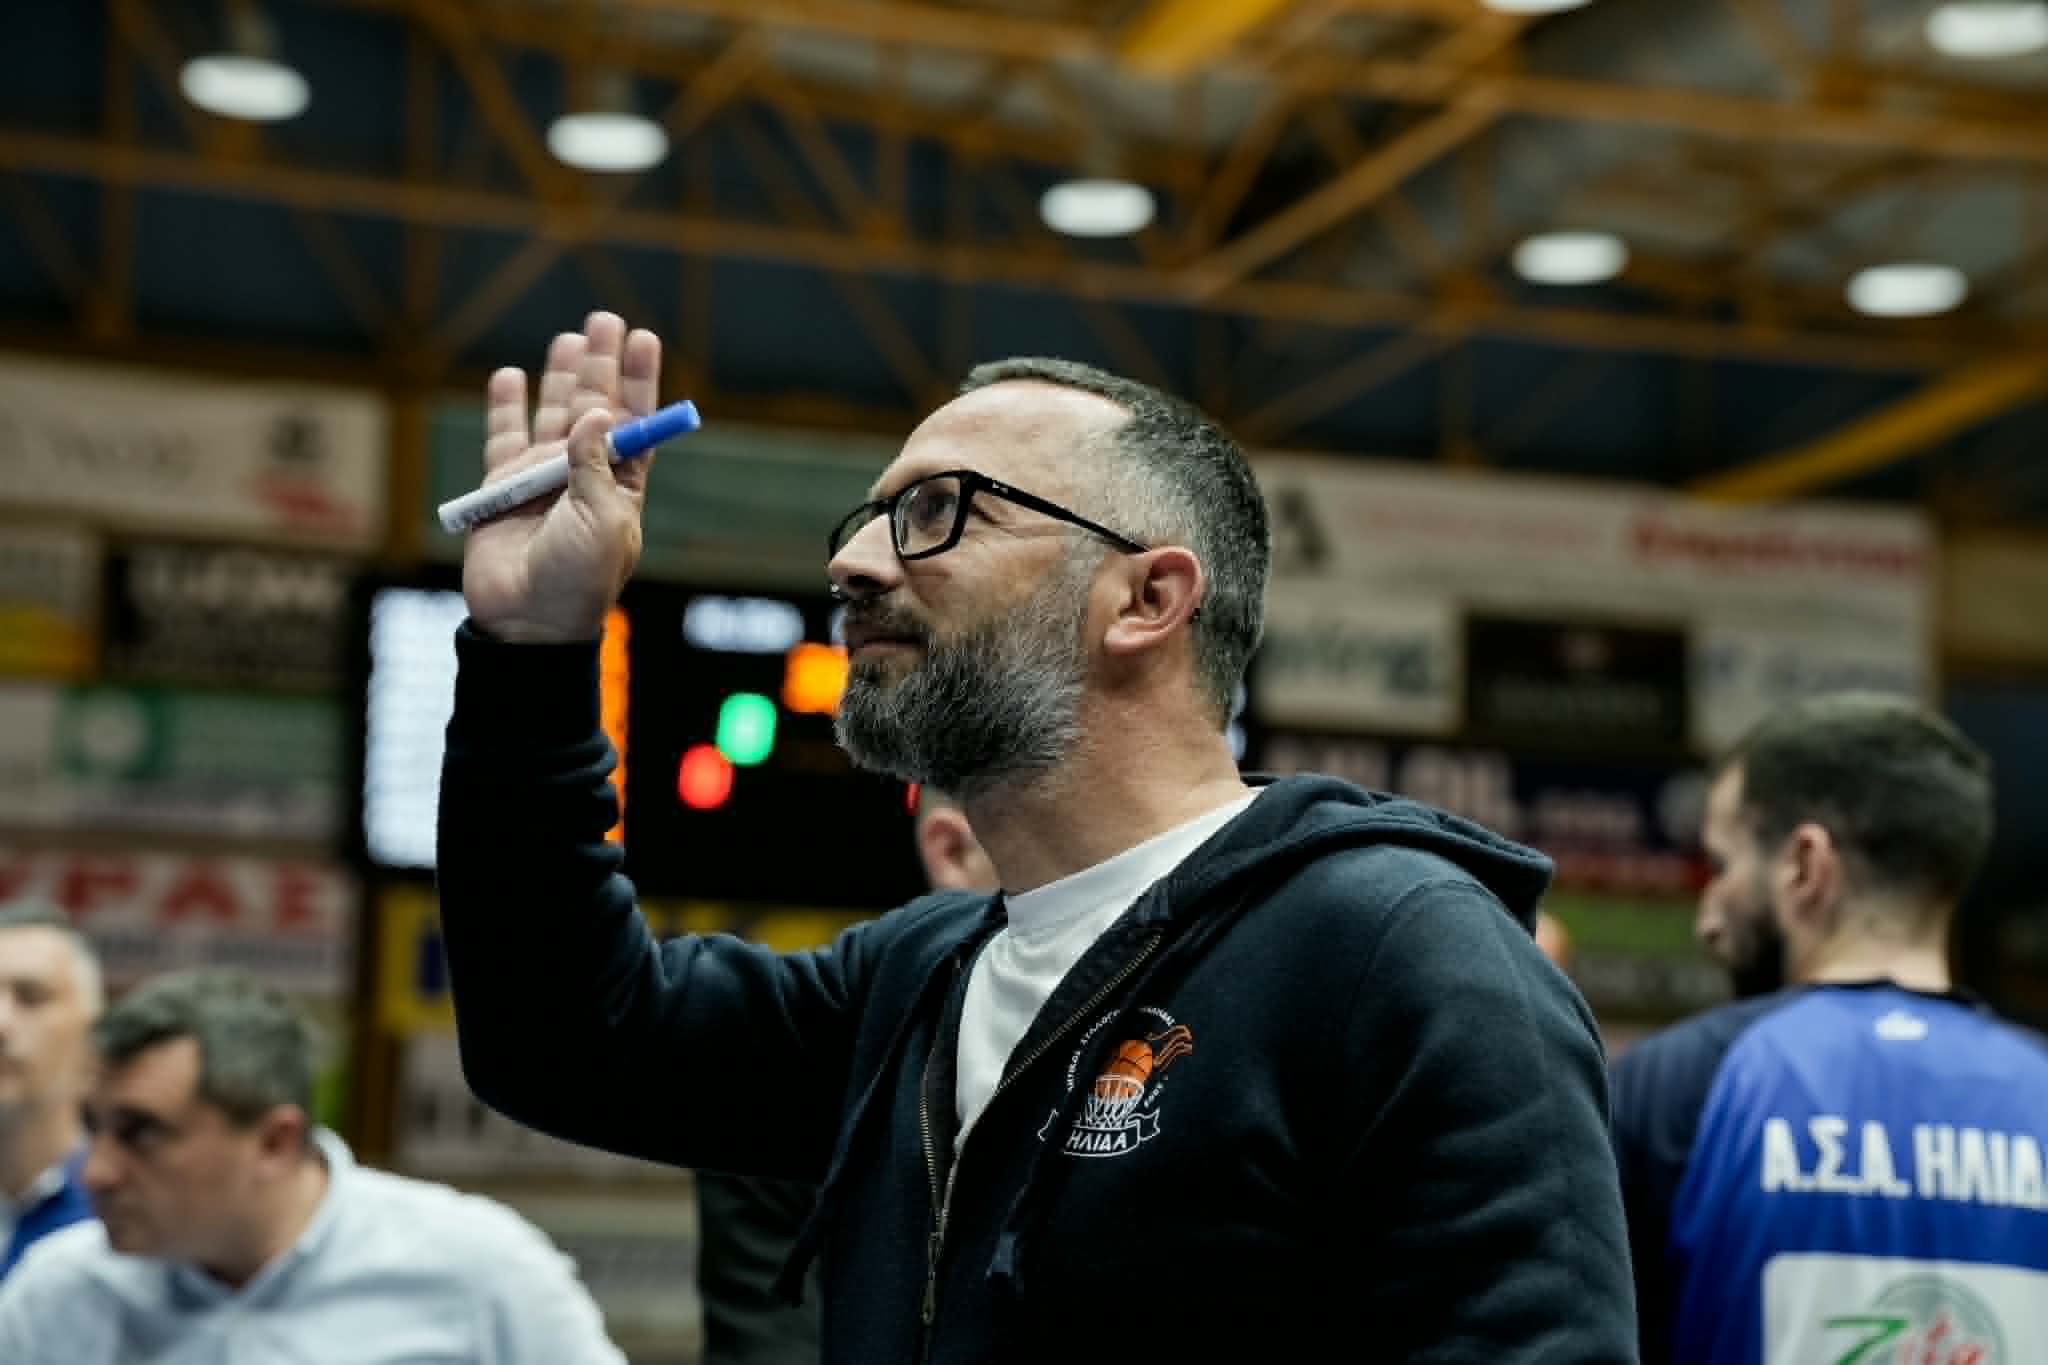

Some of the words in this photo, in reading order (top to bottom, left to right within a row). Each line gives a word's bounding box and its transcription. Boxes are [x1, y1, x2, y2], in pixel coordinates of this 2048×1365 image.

[1066, 1131, 1128, 1151] ΗΛΙΔΑ
[1762, 1116, 1911, 1197] Α.Σ.Α.
[1914, 1124, 2048, 1210] ΗΛΙΔ
